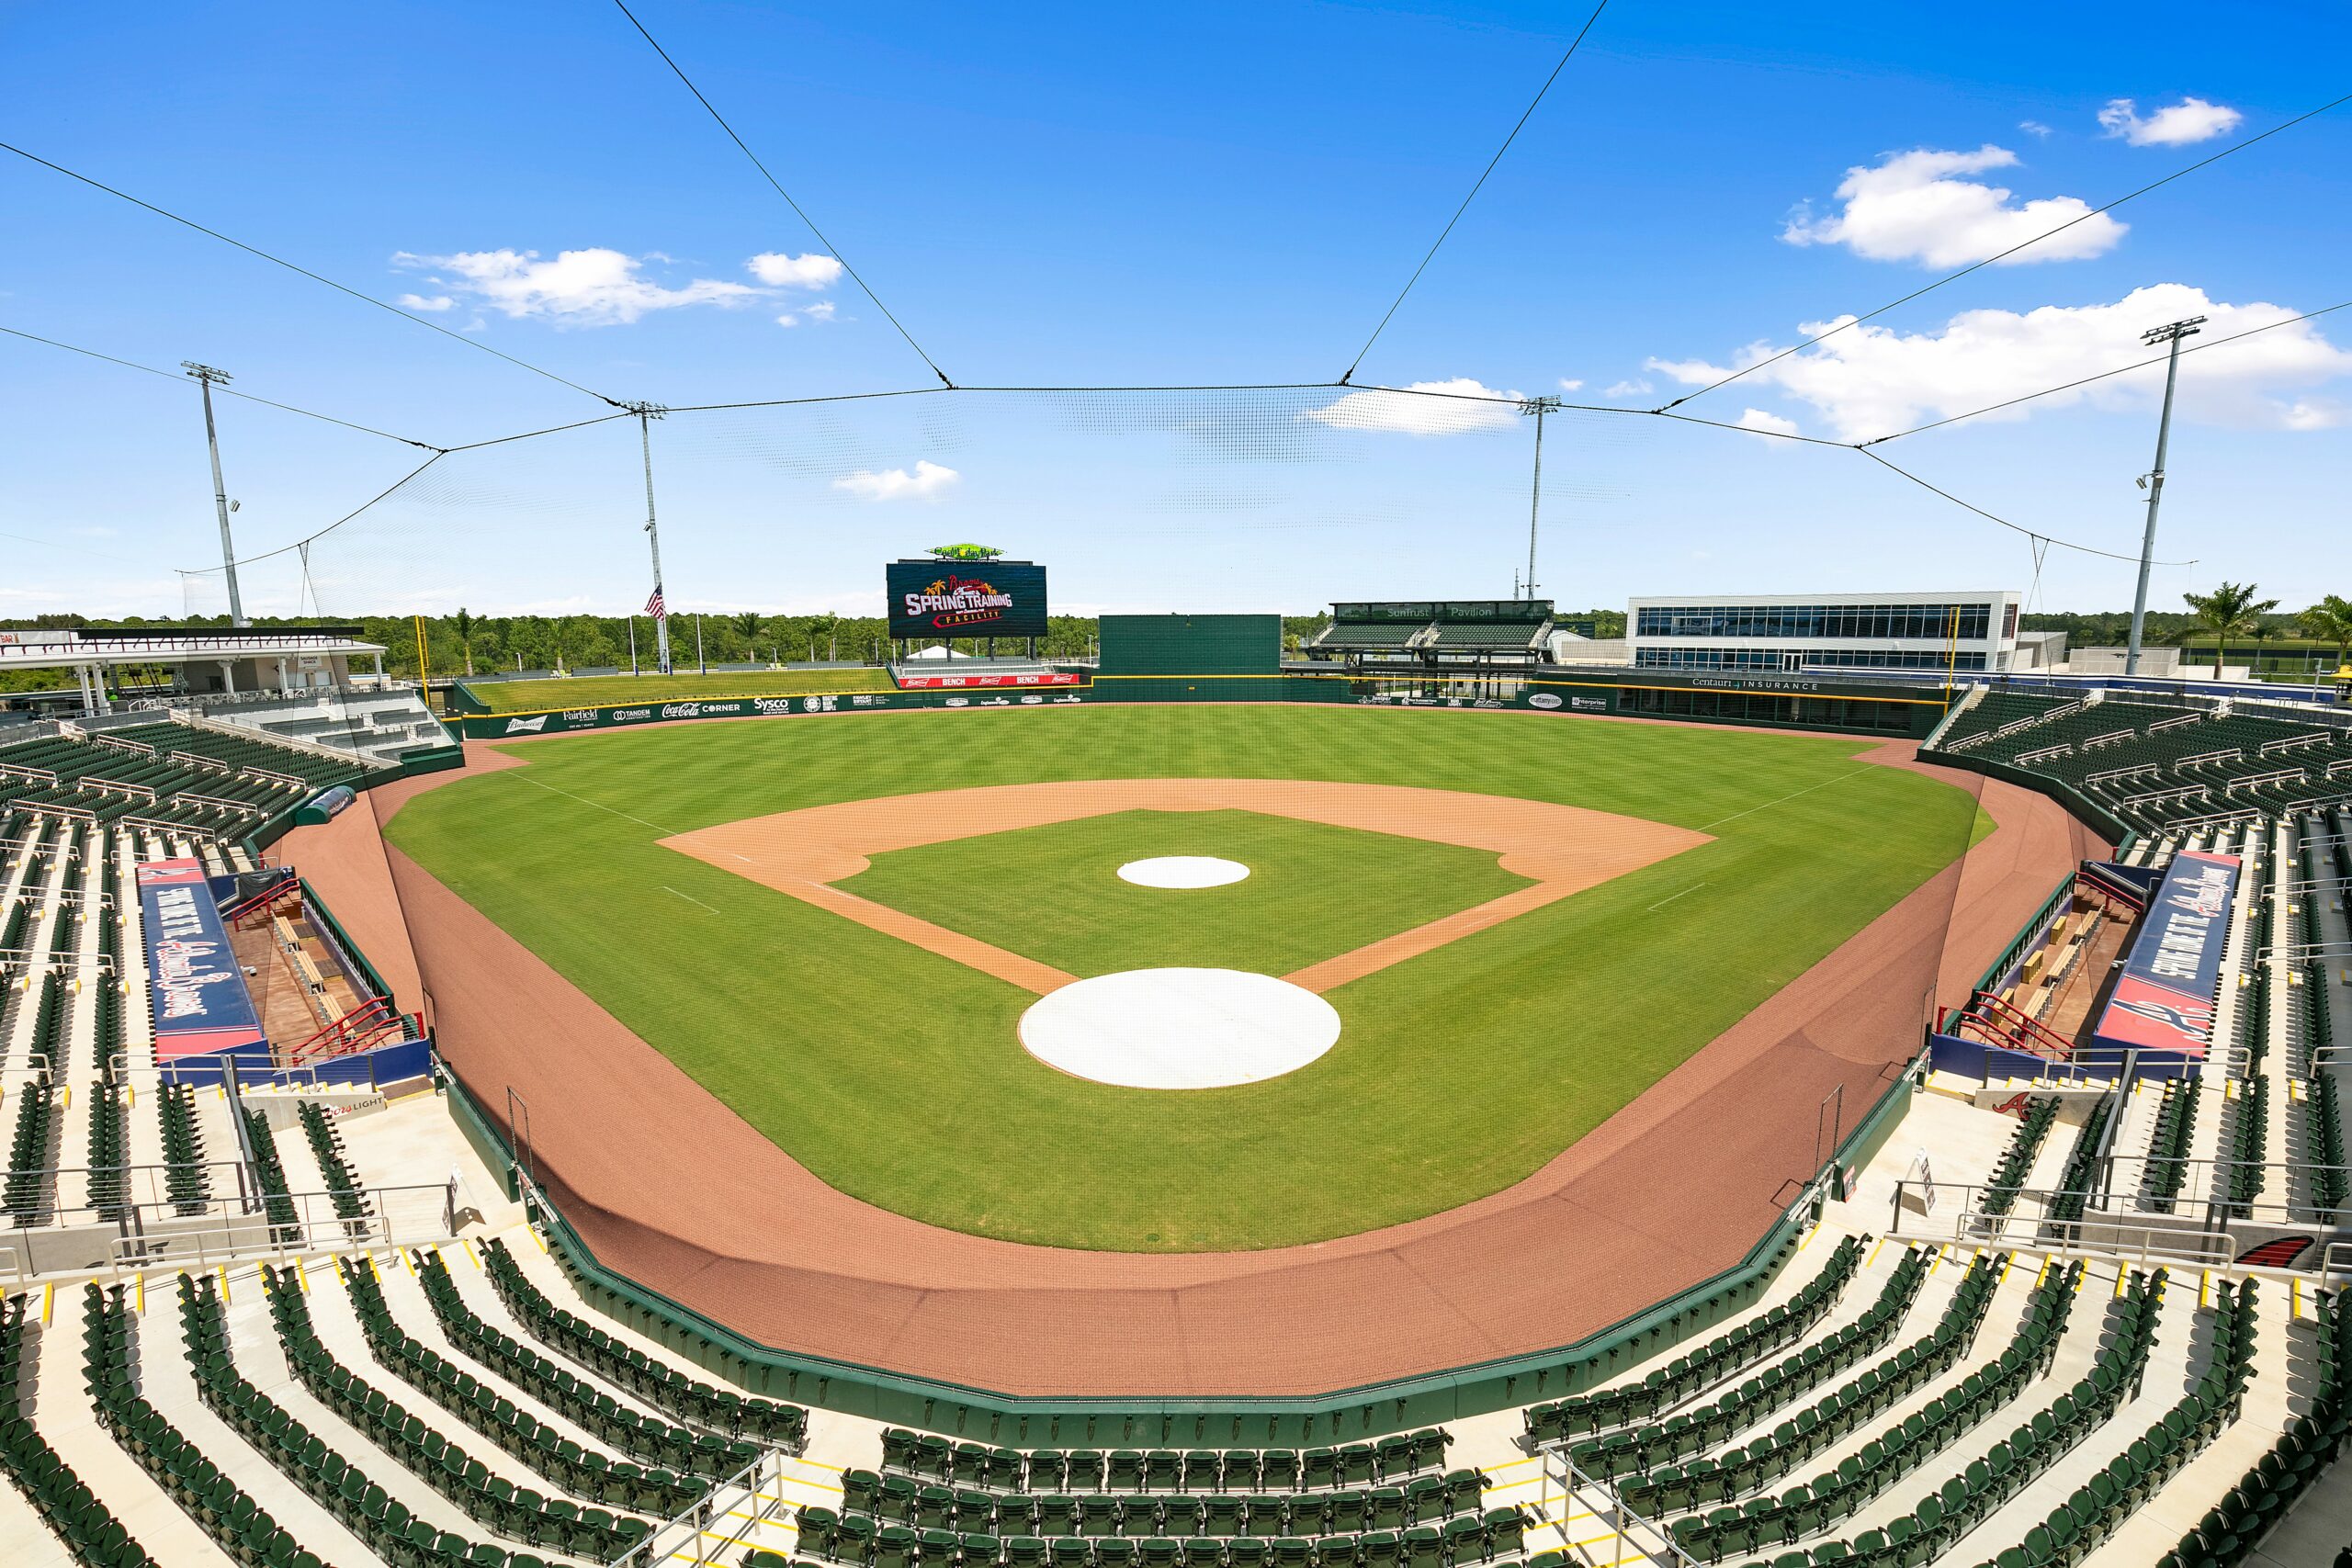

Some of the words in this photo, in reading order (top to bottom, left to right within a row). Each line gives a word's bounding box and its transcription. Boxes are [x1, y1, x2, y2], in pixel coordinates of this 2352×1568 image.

[905, 593, 967, 615] SPRING
[967, 593, 1012, 609] TRAINING
[945, 611, 999, 624] FACILITY
[1387, 608, 1429, 617] SunTrust
[1451, 607, 1492, 616] Pavilion
[943, 678, 966, 686] BENCH
[1017, 676, 1038, 684] BENCH
[1692, 678, 1731, 687] Centauri
[1743, 681, 1818, 691] INSURANCE
[702, 705, 740, 713] CORNER
[754, 698, 788, 711] Sysco
[563, 709, 598, 721] Fairfield
[509, 720, 543, 730] Budweiser
[353, 1097, 383, 1111] LIGHT
